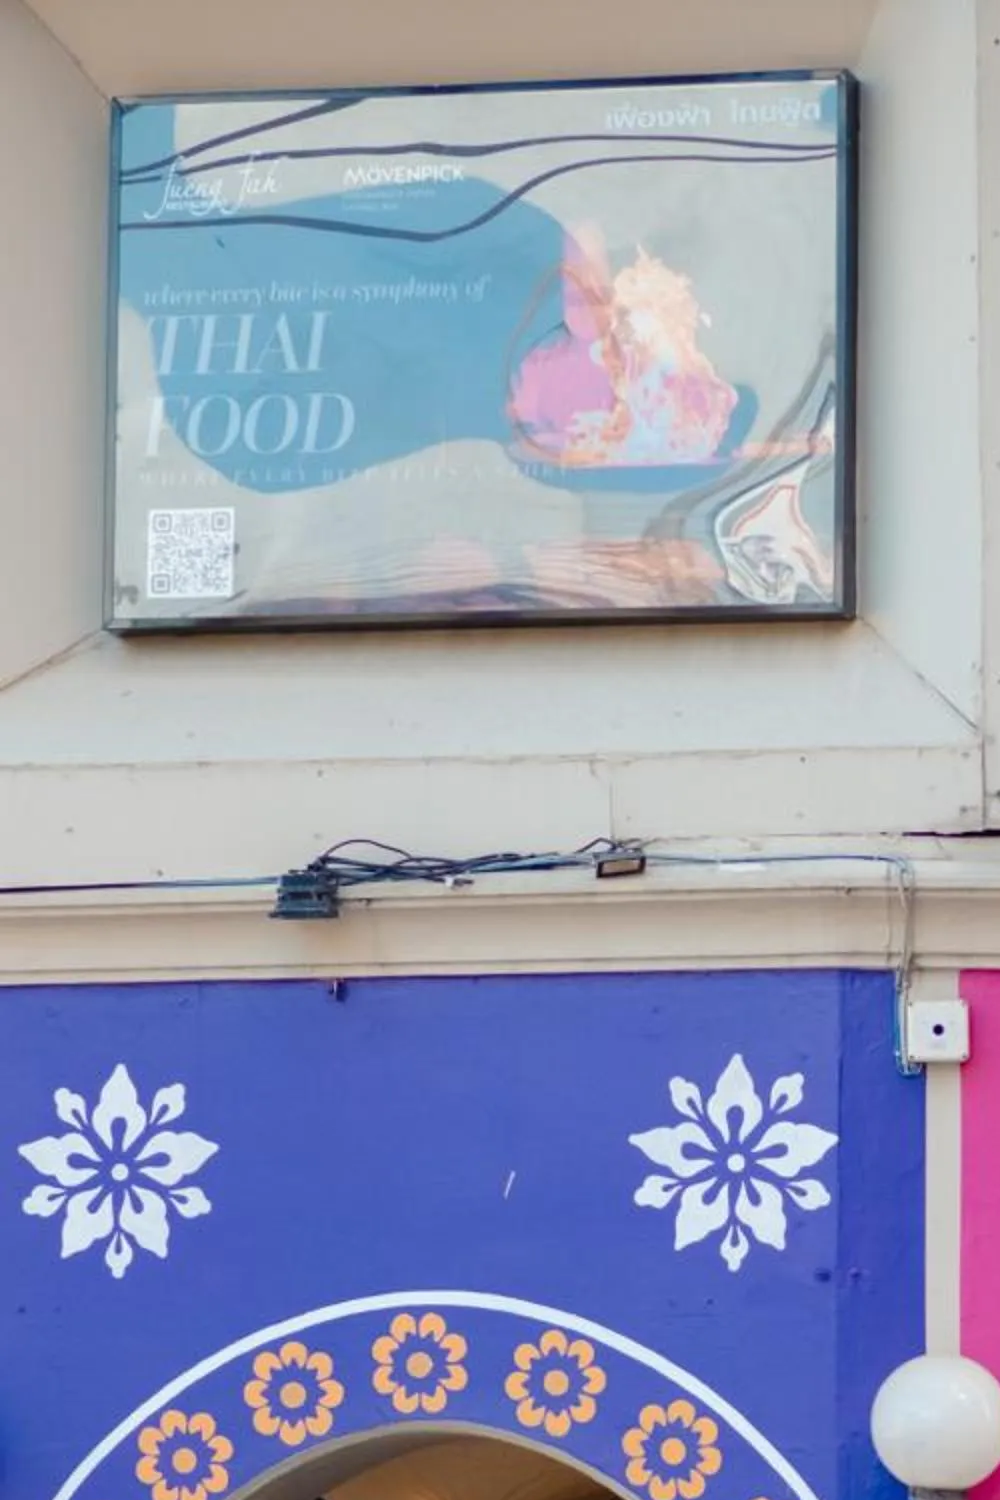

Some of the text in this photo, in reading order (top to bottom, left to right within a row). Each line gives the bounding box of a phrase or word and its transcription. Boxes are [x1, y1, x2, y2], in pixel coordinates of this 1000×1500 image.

[465, 272, 492, 303] of
[147, 310, 333, 375] THAI
[144, 390, 357, 459] FOOD
